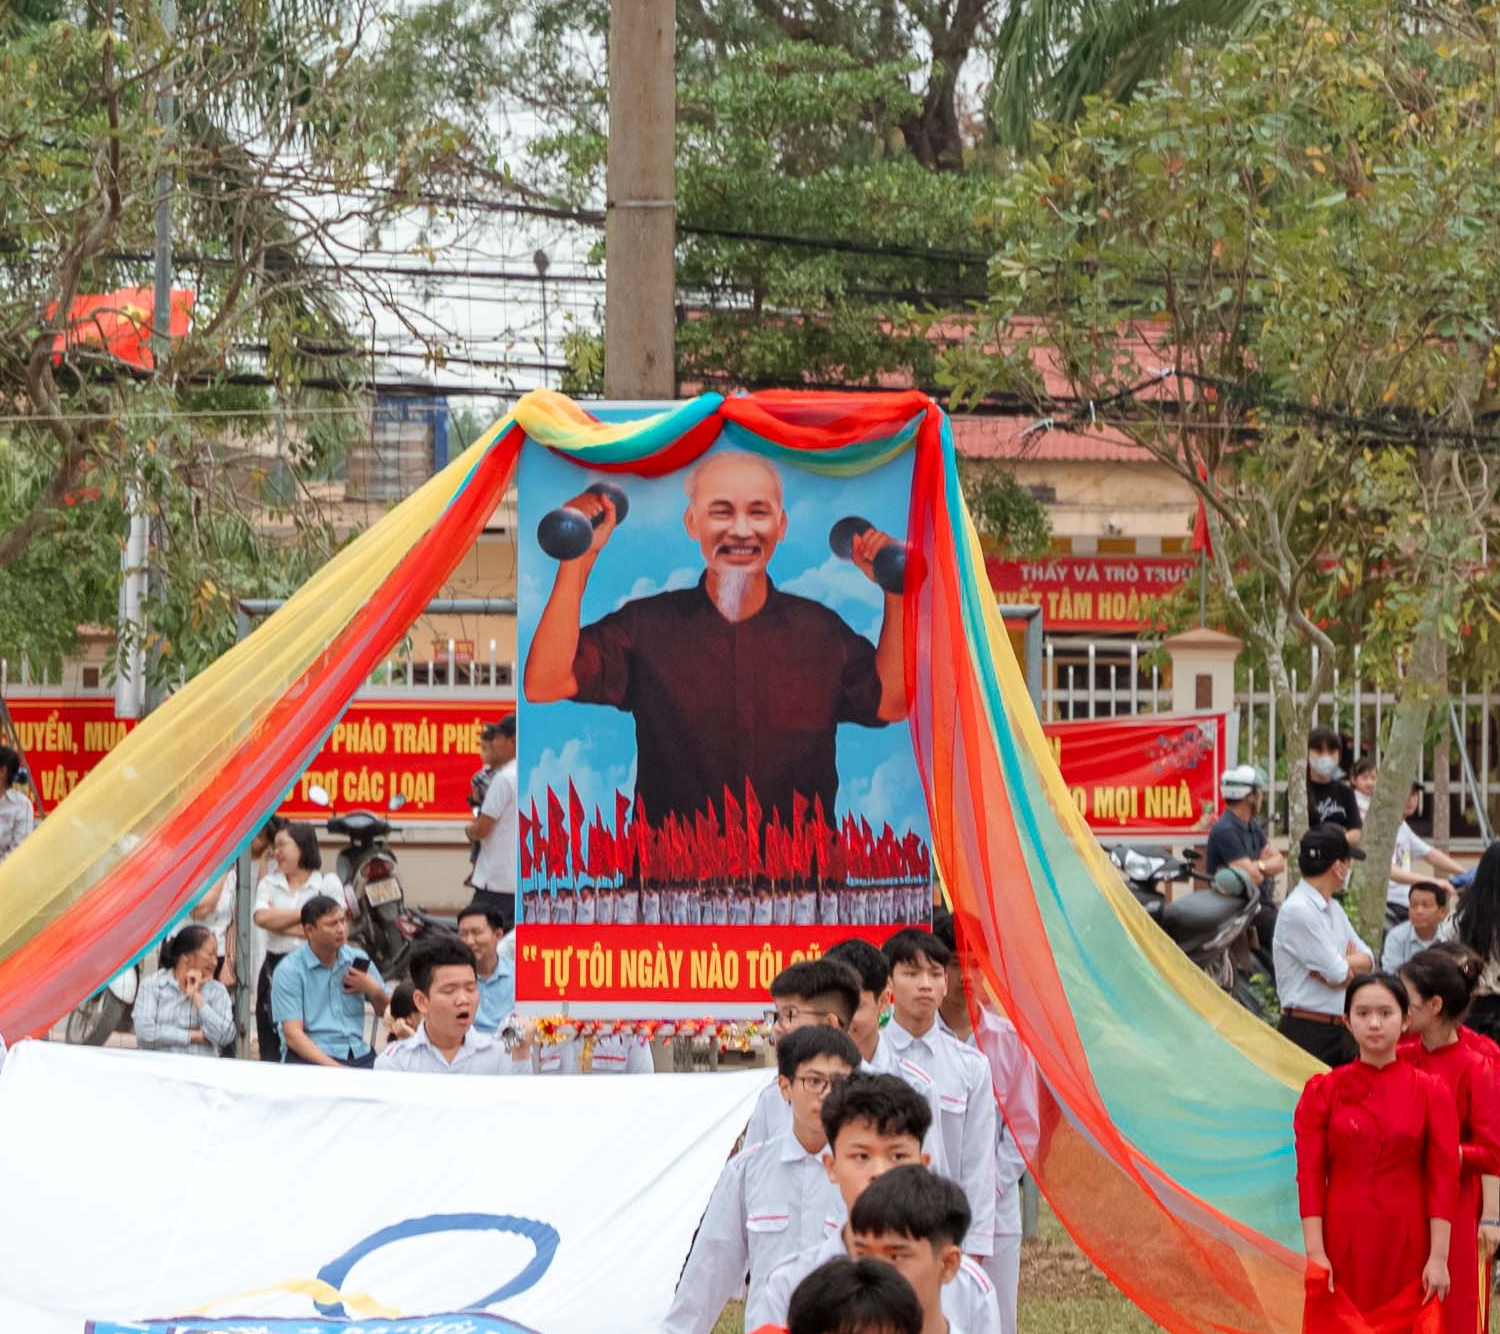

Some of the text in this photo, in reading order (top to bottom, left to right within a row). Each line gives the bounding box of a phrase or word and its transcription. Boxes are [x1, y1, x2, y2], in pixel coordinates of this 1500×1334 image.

[1048, 585, 1092, 620] TÂM
[332, 717, 387, 753] PHÁO
[392, 717, 437, 754] TRÁI
[443, 717, 483, 754] PHÉ
[344, 766, 385, 802] CÁC
[1094, 786, 1138, 825] MỌI
[1144, 779, 1193, 818] NHÀ
[577, 941, 613, 987] TÔI
[620, 941, 683, 988] NGÀY
[690, 941, 739, 989] NÀO
